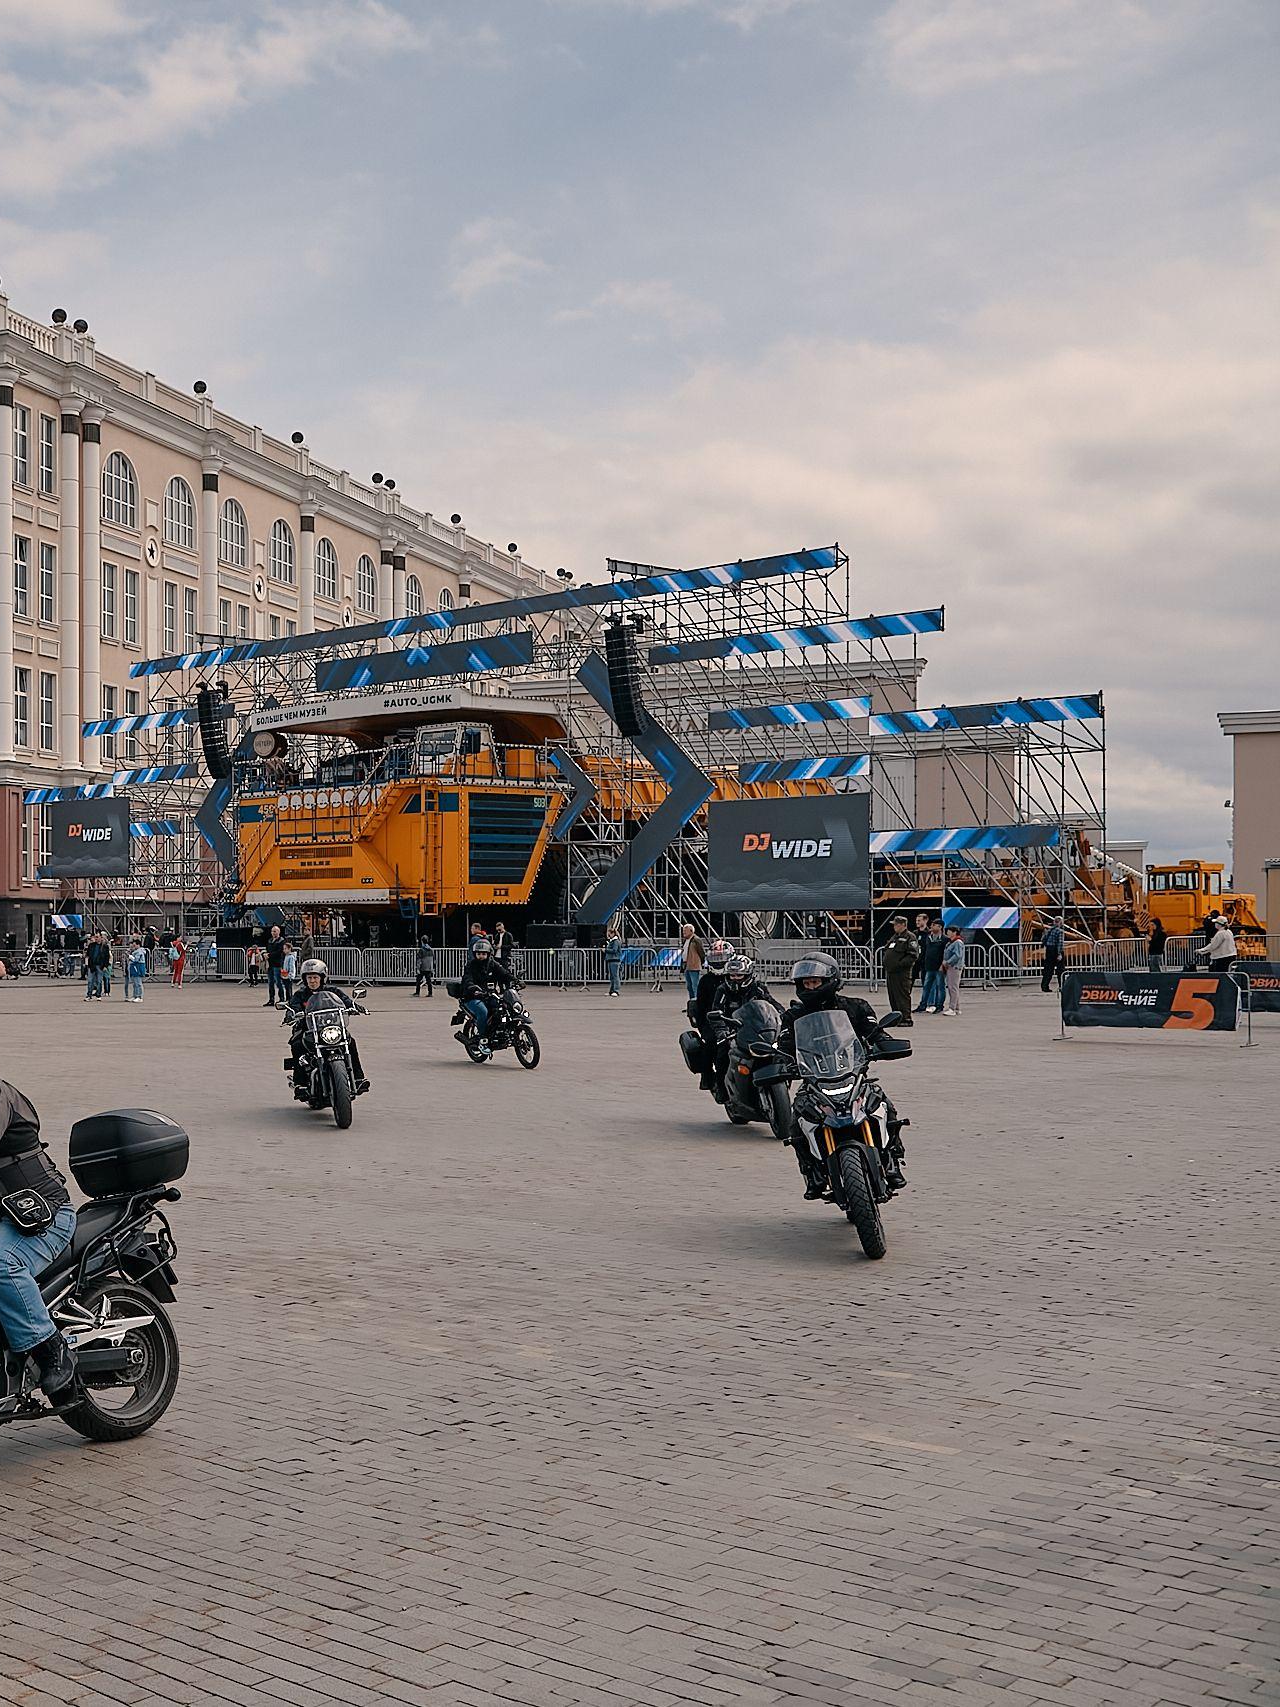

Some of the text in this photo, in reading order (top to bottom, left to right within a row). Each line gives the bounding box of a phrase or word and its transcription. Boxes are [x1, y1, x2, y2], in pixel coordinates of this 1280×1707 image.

[383, 694, 452, 709] #AUTO_UGMK
[256, 706, 327, 726] БОЛЬШЕ ЧЕМ МУЗЕЙ
[68, 824, 112, 842] DJ WIDE
[742, 833, 833, 859] DJ WIDE
[1163, 978, 1219, 1030] 5
